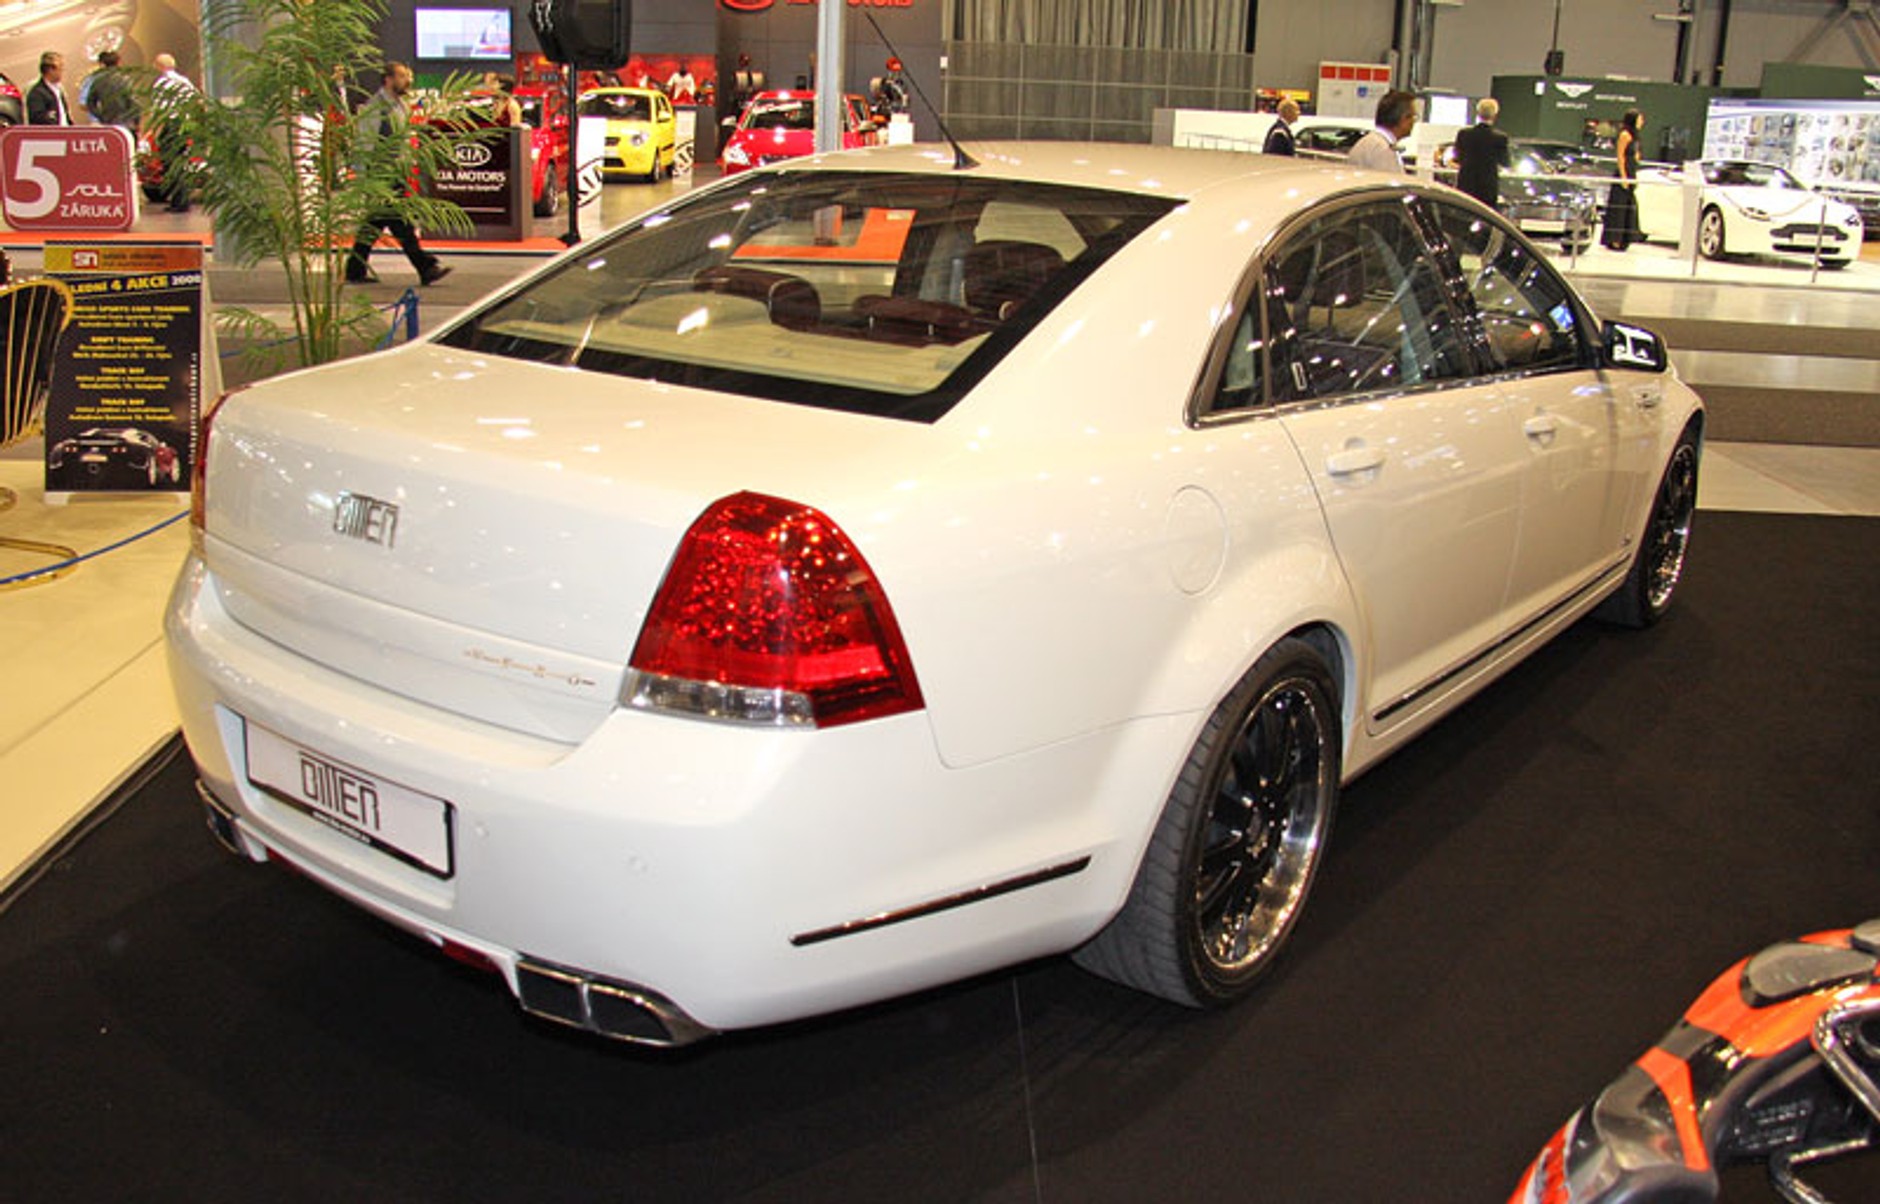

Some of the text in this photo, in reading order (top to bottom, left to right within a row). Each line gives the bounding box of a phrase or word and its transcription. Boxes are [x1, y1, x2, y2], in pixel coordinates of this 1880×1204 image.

[455, 148, 483, 161] KIA
[4, 139, 67, 219] 5
[456, 169, 507, 183] MOTORS
[110, 279, 122, 291] 4
[126, 275, 169, 290] AKCE
